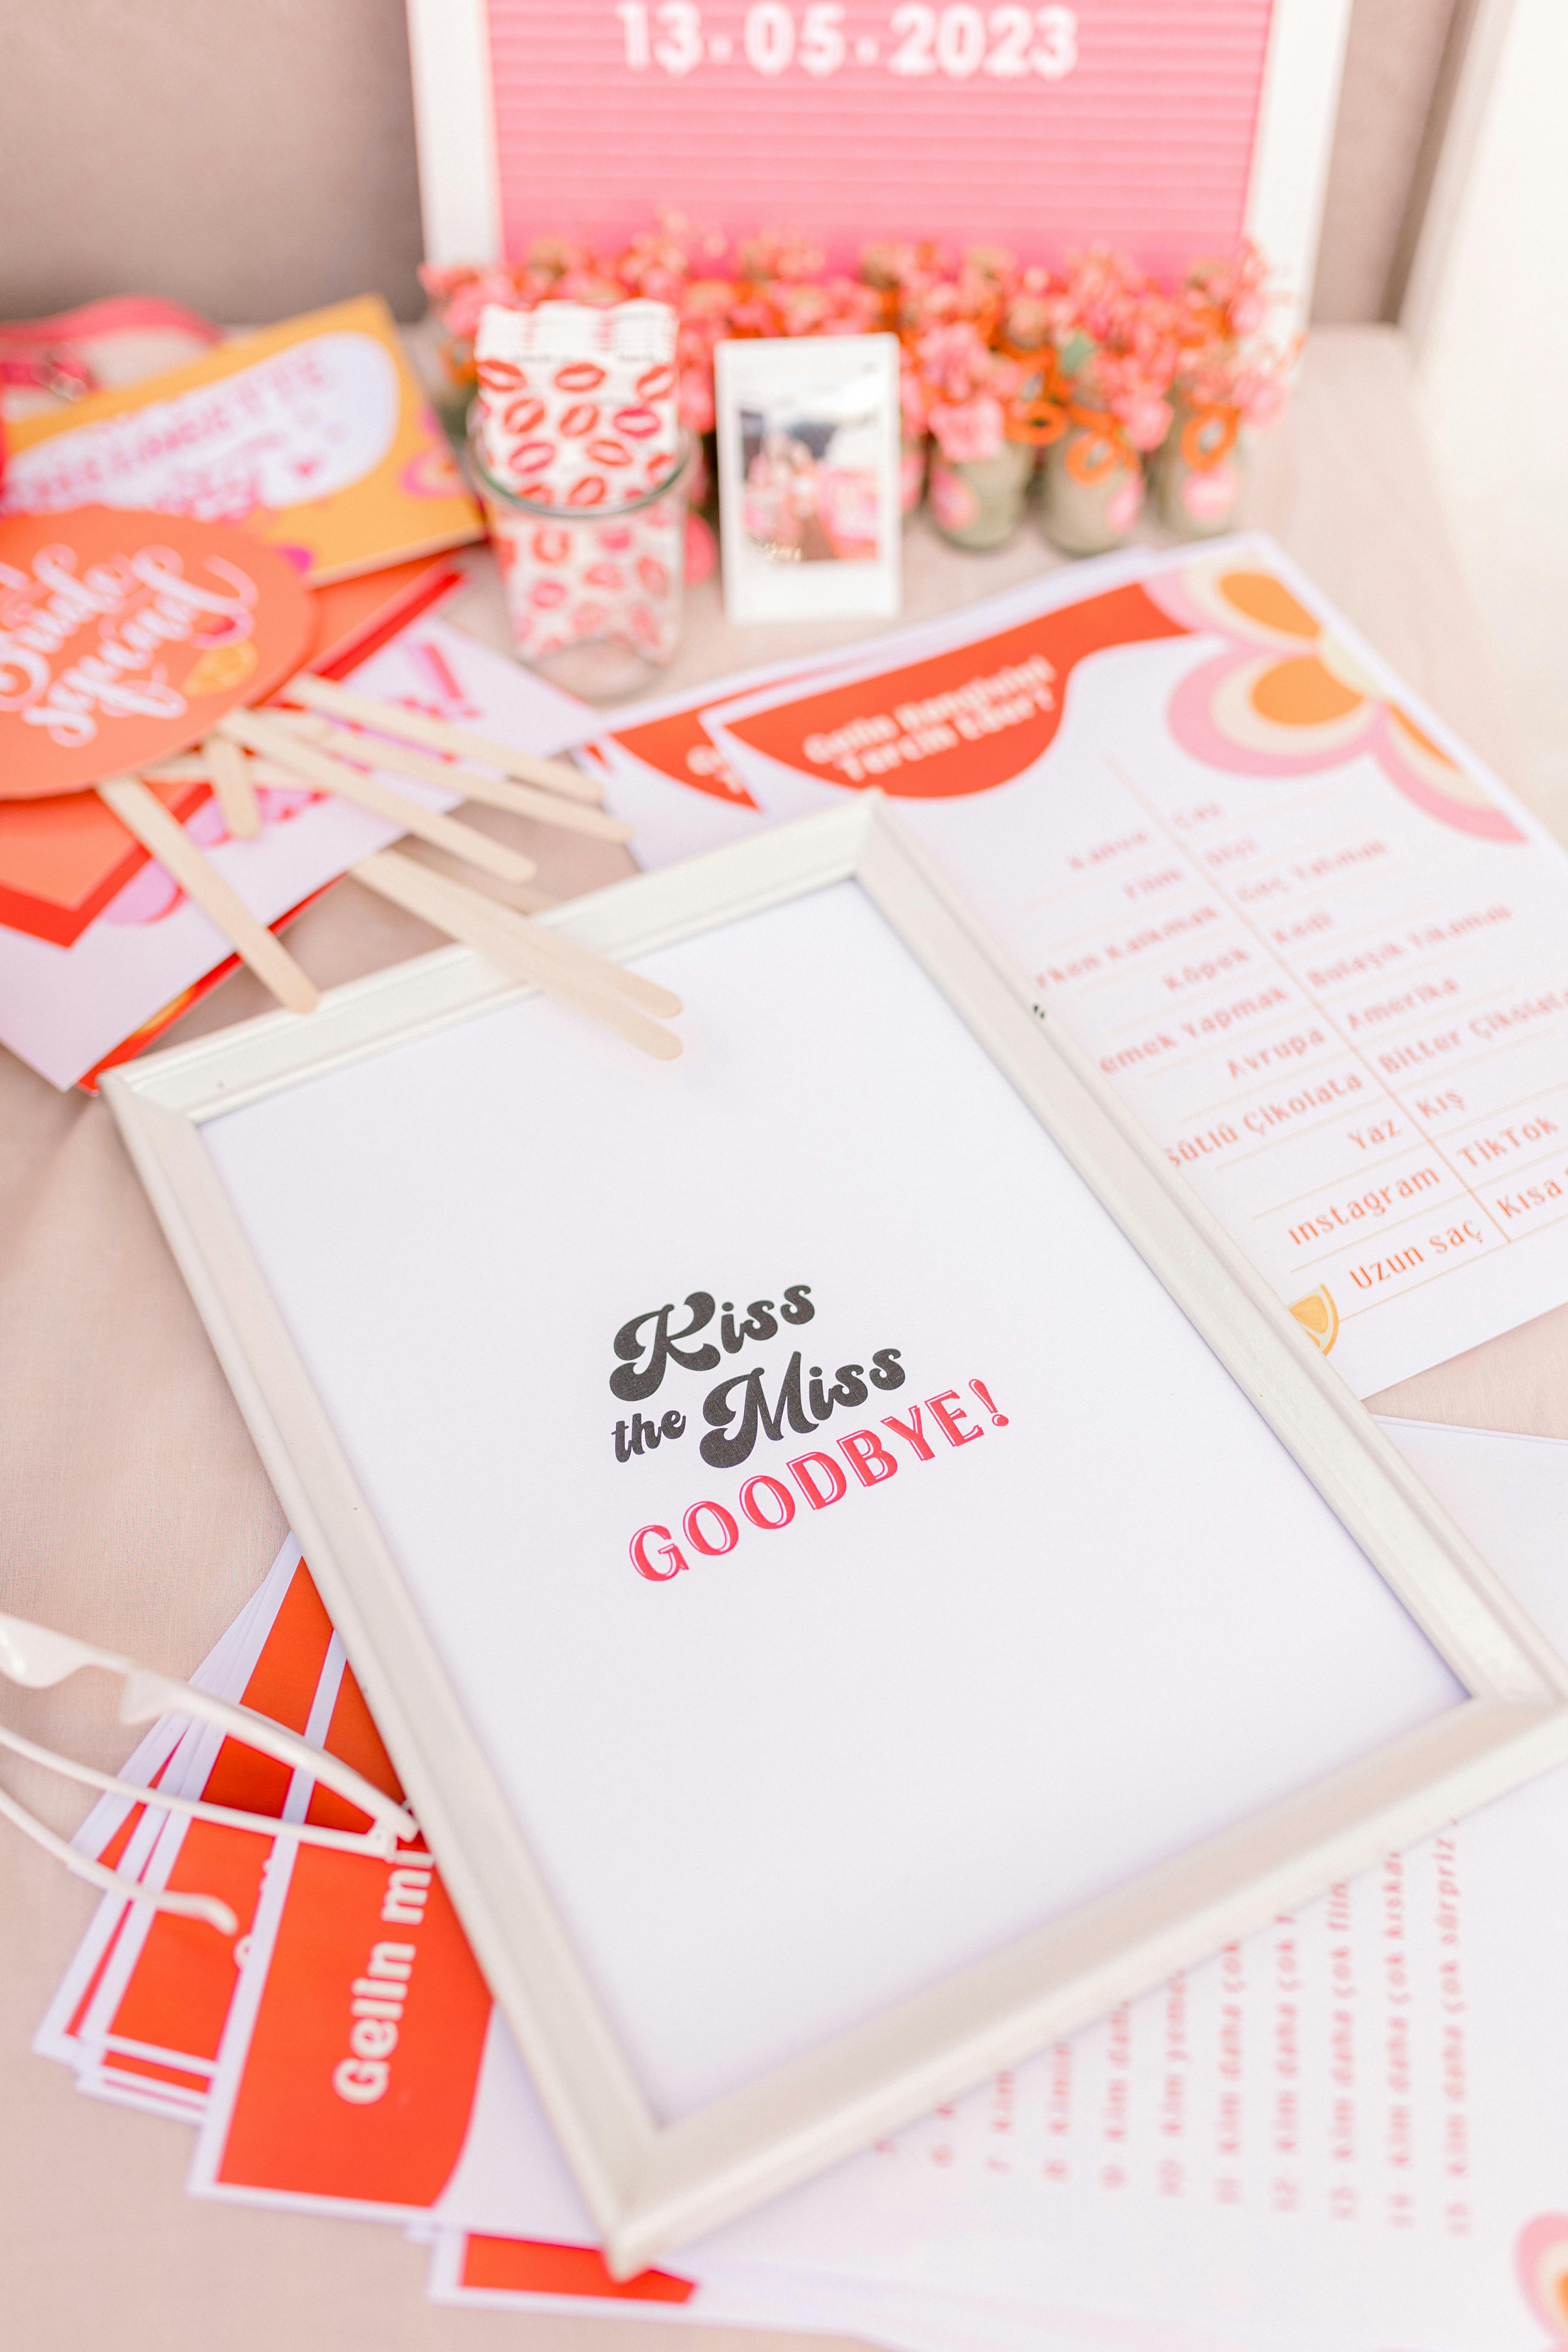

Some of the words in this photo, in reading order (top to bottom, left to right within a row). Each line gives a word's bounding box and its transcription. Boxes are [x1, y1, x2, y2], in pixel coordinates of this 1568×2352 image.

[1036, 953, 1101, 990] rken
[1099, 1032, 1177, 1075] emek
[1181, 986, 1289, 1041] Yapmak
[1345, 976, 1459, 1032] Amerika
[1225, 1026, 1326, 1079] Avrupa
[1377, 1029, 1462, 1075] Bitter
[1243, 1074, 1363, 1136] Çikolata
[1415, 1089, 1465, 1119] Kış
[1348, 1118, 1402, 1150] Yaz
[1457, 1115, 1559, 1167] TikTok
[1496, 1179, 1563, 1218] Kısa
[1349, 1245, 1424, 1288] Uzun
[1429, 1219, 1483, 1254] saç
[609, 1284, 815, 1401] Kiss
[611, 1410, 686, 1463] the
[699, 1348, 906, 1468] Miss
[629, 1378, 1009, 1581] GOODBYE!
[332, 1942, 416, 2105] Gelin
